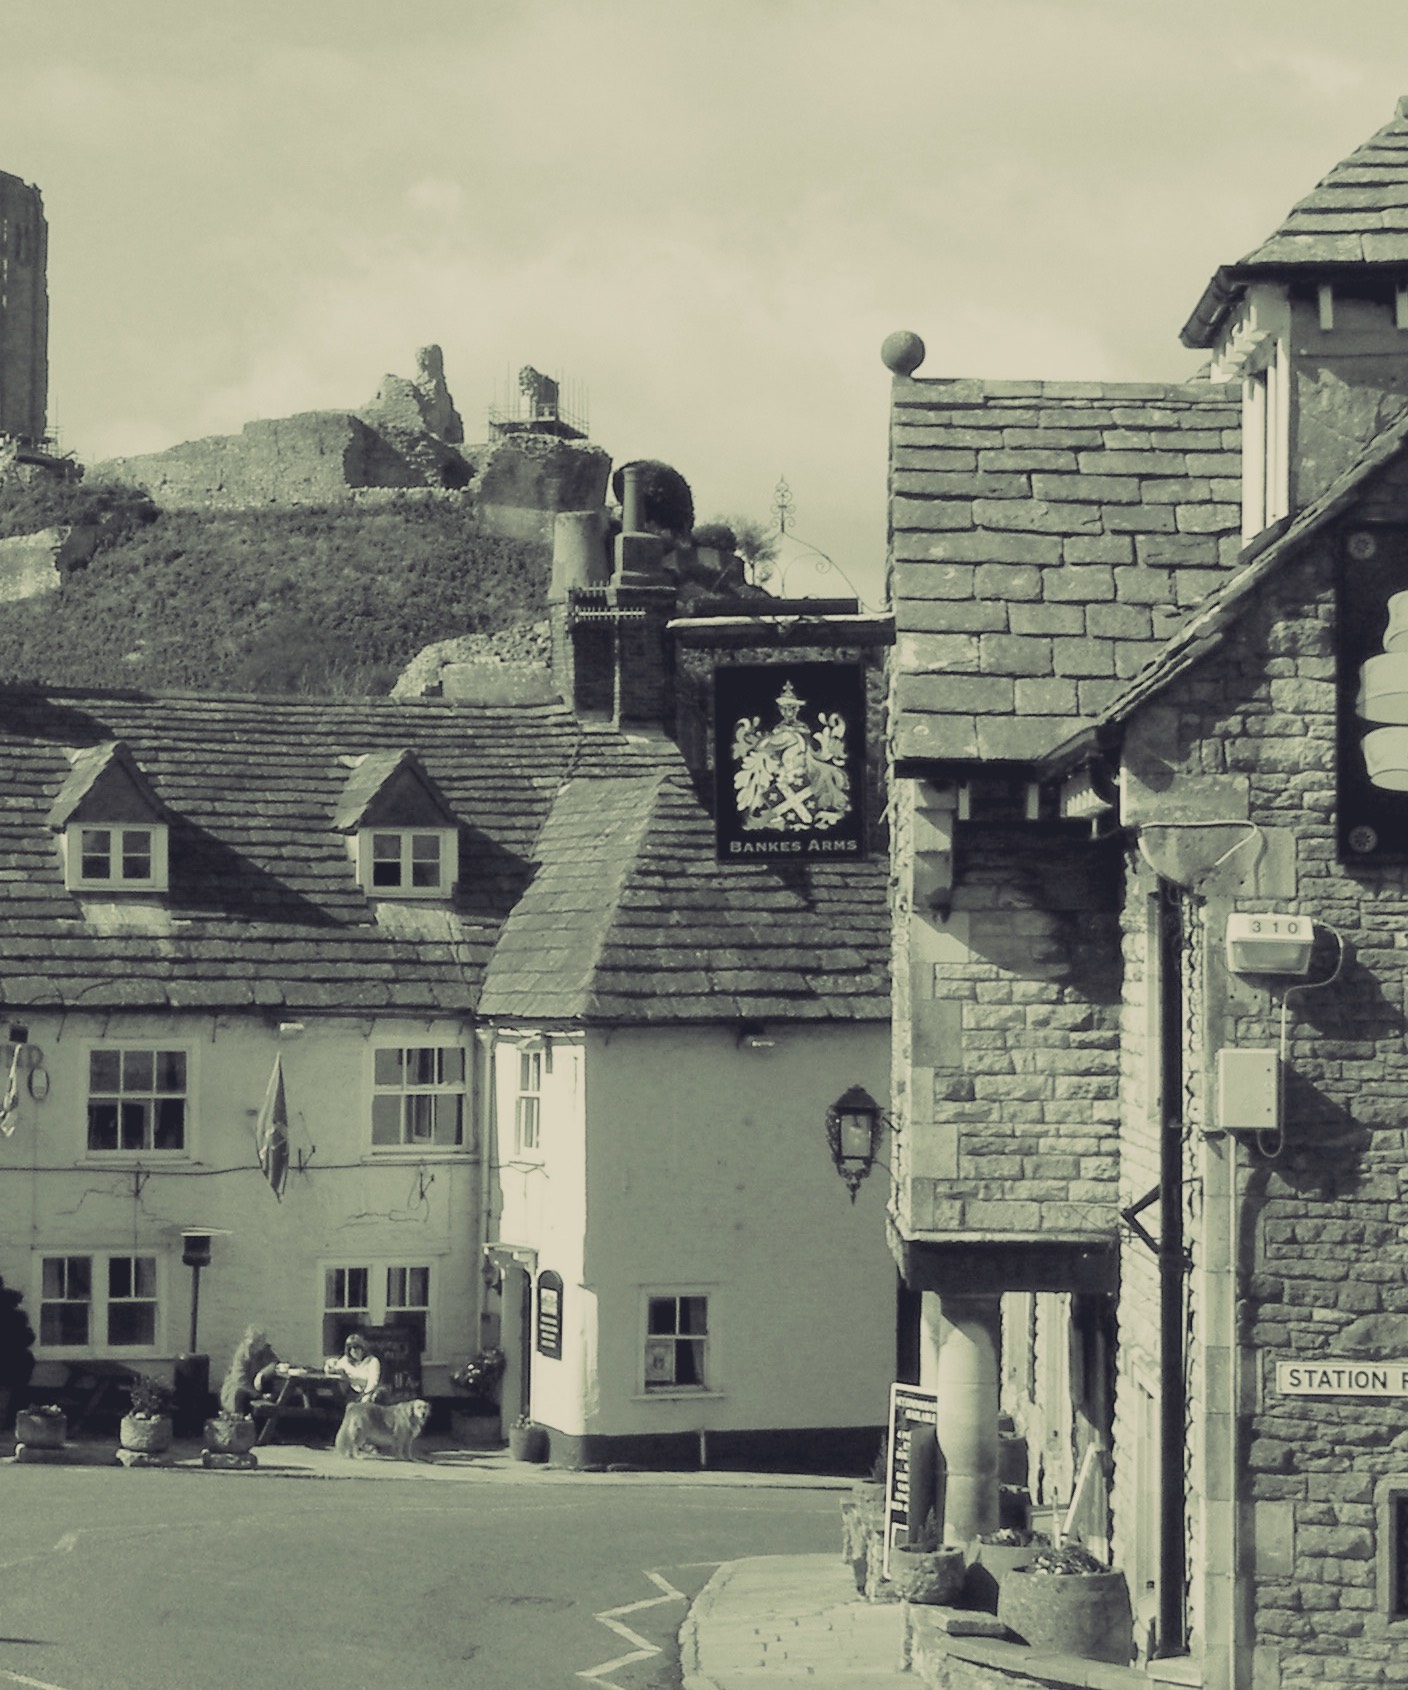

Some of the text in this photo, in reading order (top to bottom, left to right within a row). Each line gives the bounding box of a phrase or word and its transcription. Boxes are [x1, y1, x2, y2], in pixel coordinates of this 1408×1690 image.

[729, 839, 858, 853] BANKES ARMS
[1252, 921, 1298, 934] 310
[1289, 1368, 1388, 1389] STATION
